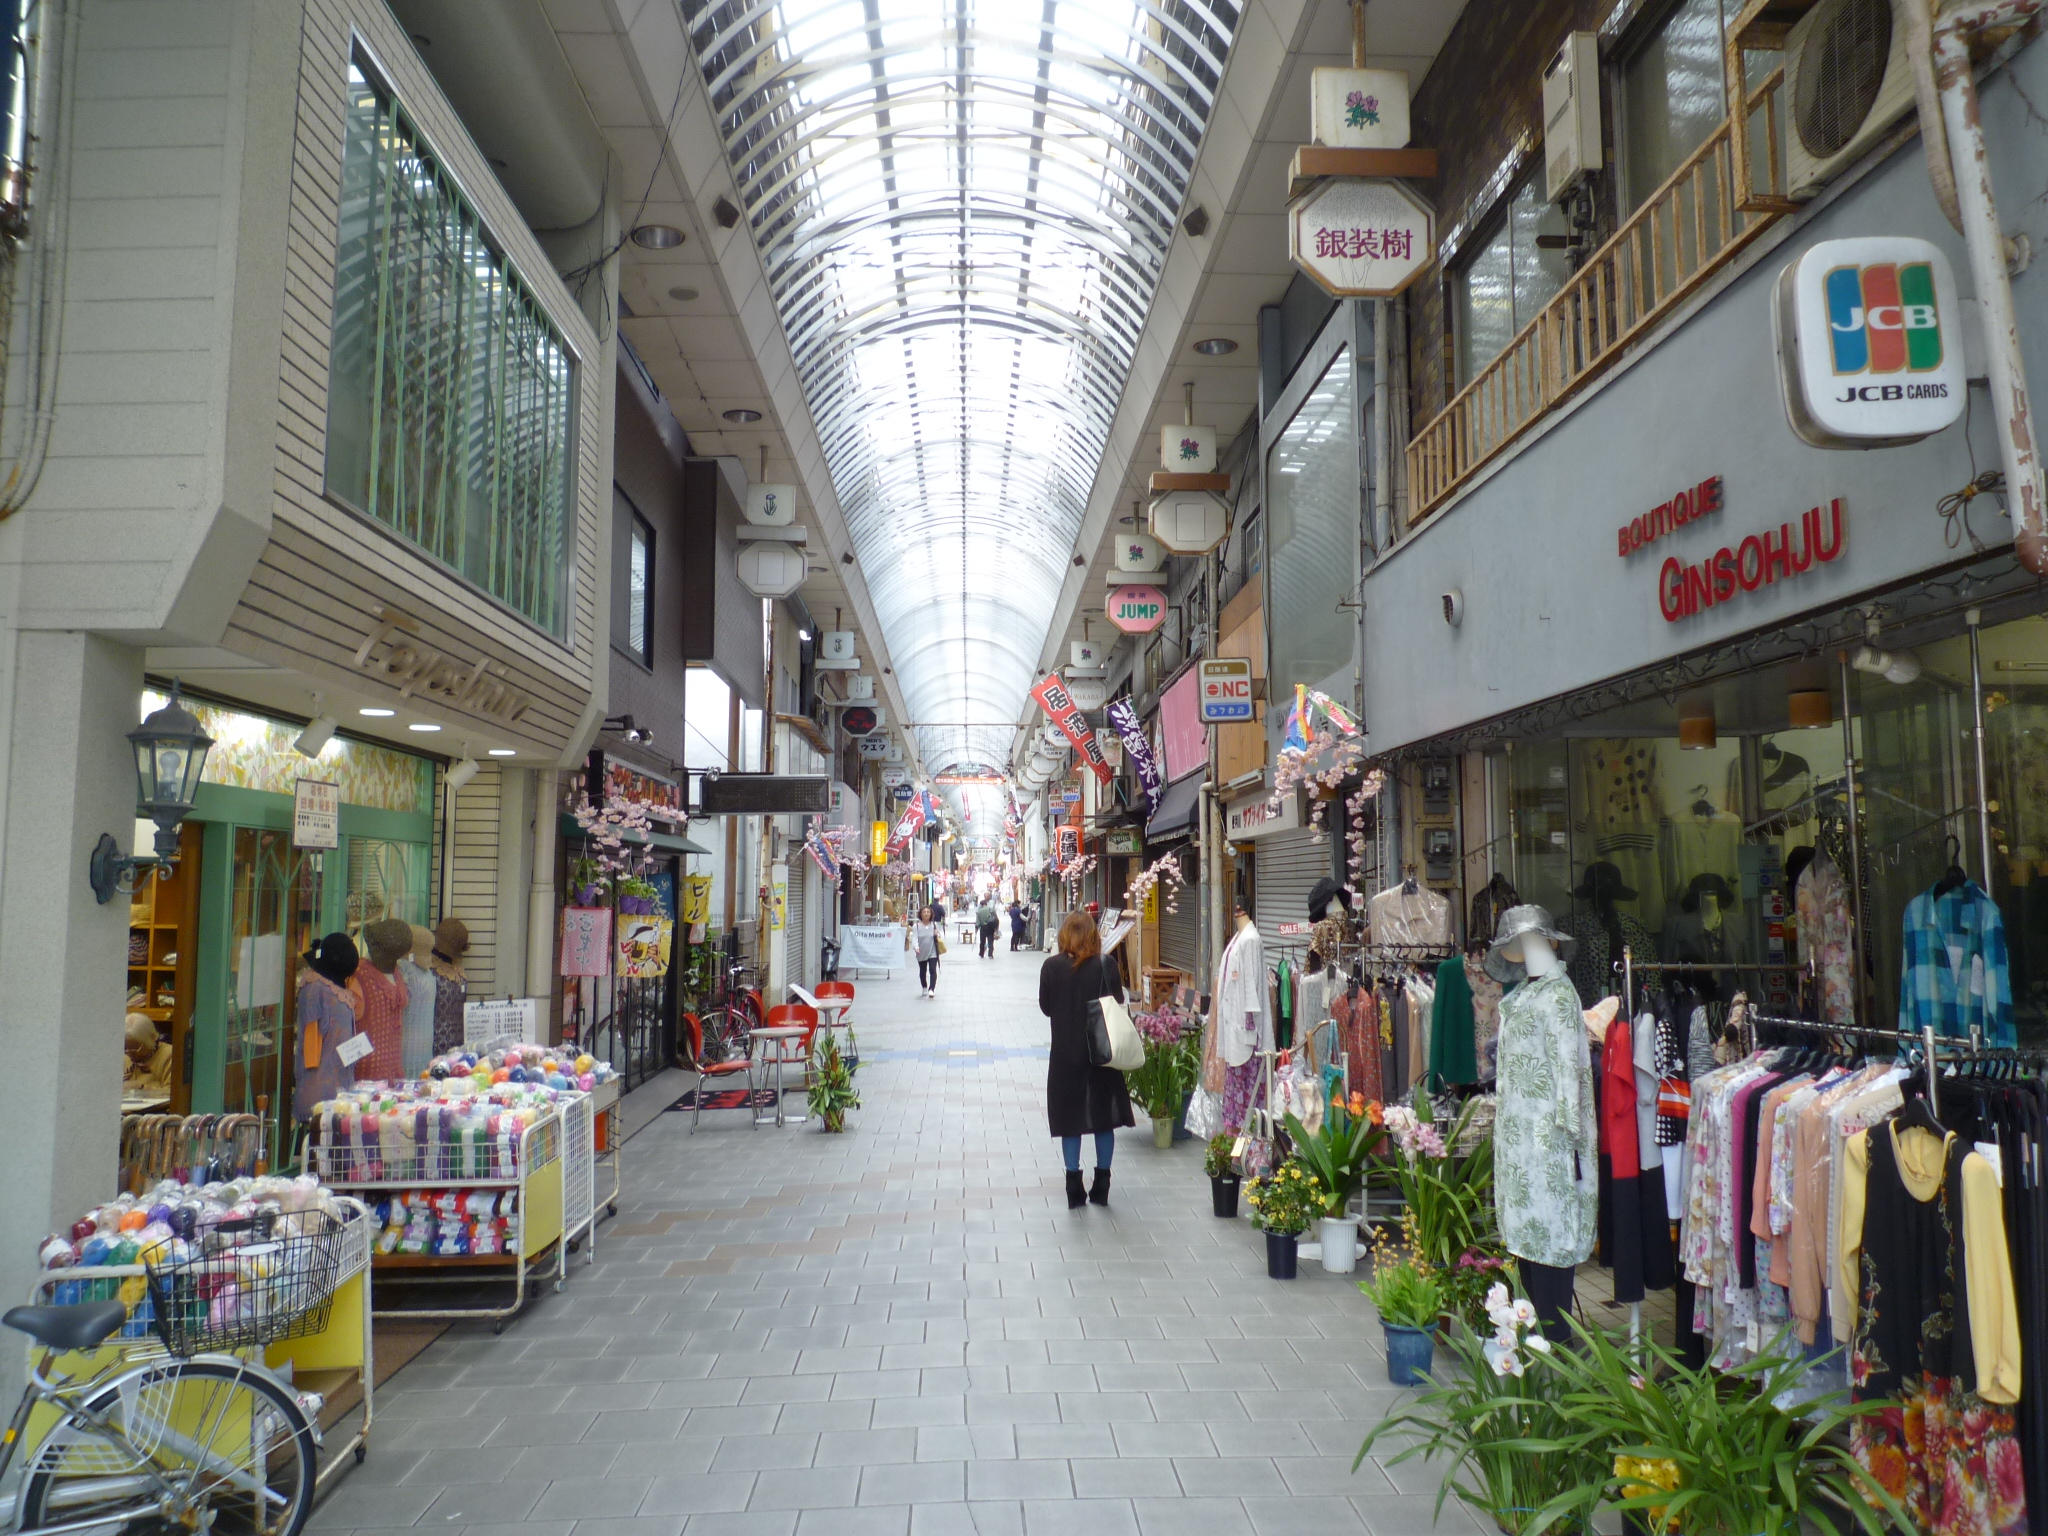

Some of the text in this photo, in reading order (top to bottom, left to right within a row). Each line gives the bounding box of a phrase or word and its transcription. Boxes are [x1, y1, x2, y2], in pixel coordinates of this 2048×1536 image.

[1313, 227, 1414, 261] 銀装樹
[1830, 304, 1938, 333] JCB
[1835, 382, 1949, 403] JCB CARDS
[1618, 474, 1725, 558] BOUTIQUE
[1658, 496, 1849, 623] GINSOHJU
[1116, 603, 1161, 620] JUMP
[1222, 681, 1249, 698] NC
[1042, 685, 1105, 766] 居酒屋
[687, 880, 707, 921] ビール
[575, 913, 595, 972] 営業中
[1280, 924, 1298, 935] SALE
[620, 940, 640, 975] ビール
